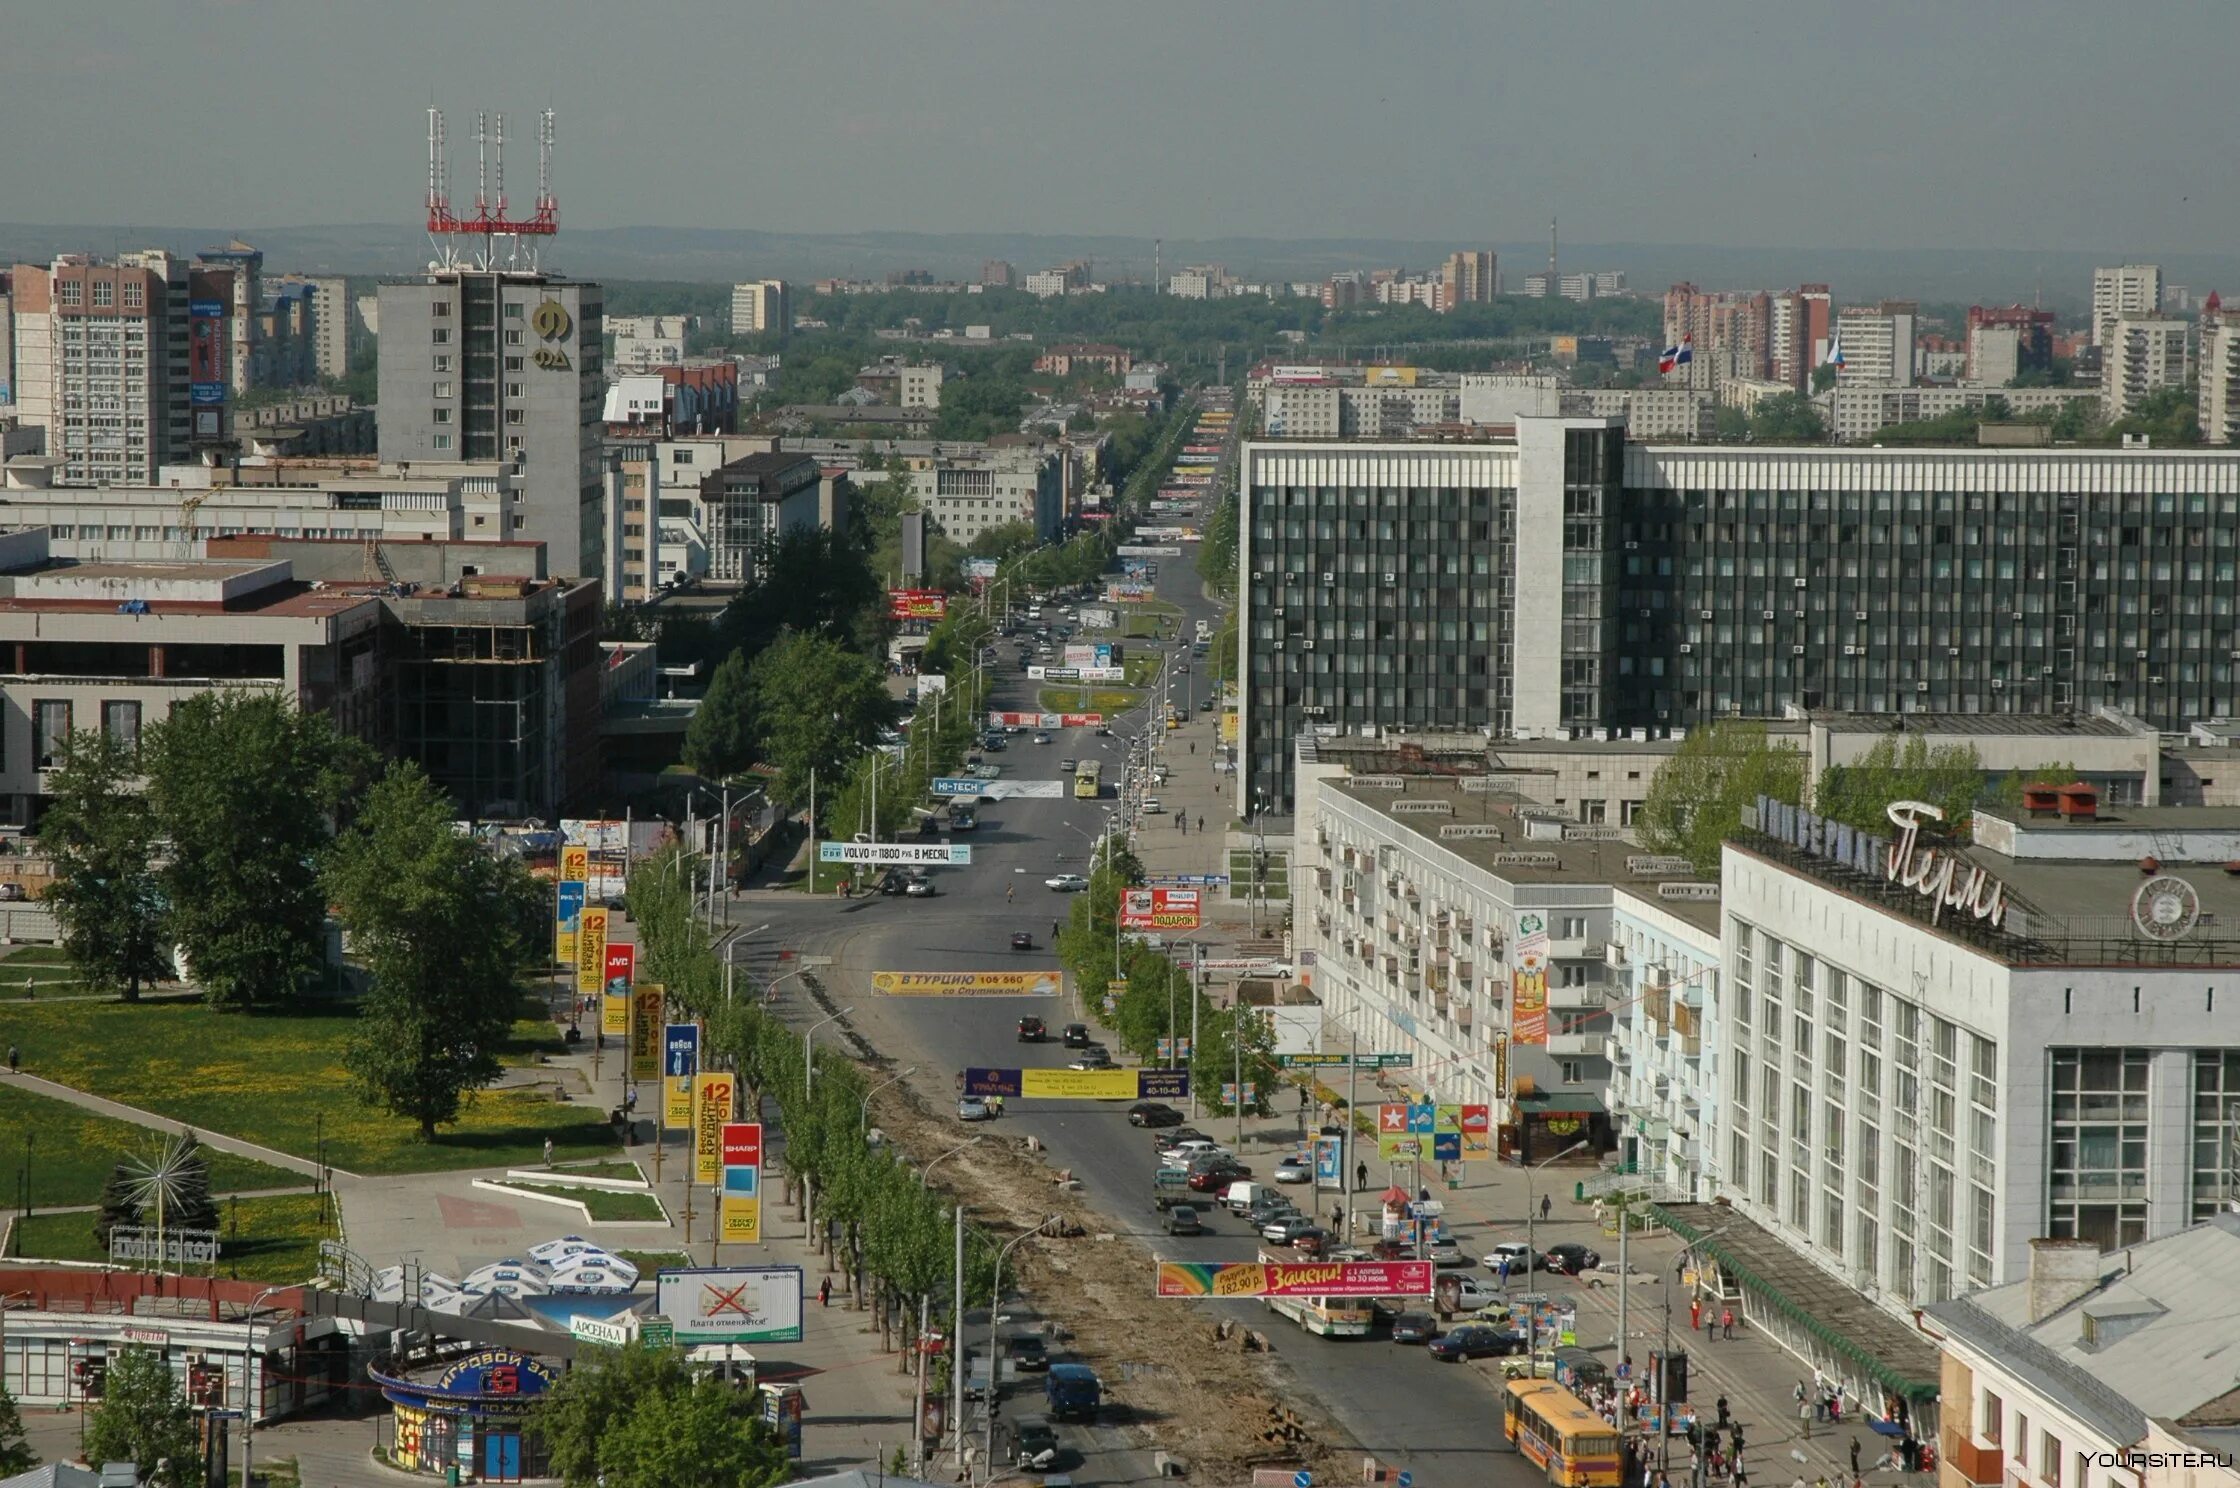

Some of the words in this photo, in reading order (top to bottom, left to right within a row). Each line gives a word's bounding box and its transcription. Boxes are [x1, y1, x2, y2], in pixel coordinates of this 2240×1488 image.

[938, 782, 978, 791] HI-TECH
[568, 854, 586, 867] 12
[844, 847, 869, 859] VOLVO
[878, 848, 900, 860] 11800
[914, 849, 920, 859] В
[922, 849, 949, 861] МЕСЯЦ
[1886, 800, 2006, 927] Пермь
[586, 916, 605, 930] 12
[1154, 915, 1196, 926] ПОДАРОК!
[1517, 949, 1543, 958] МАСЛО
[609, 957, 629, 966] JVC
[901, 975, 910, 985] В
[915, 974, 975, 986] ТУРЦИЮ
[957, 986, 1025, 996] Спутником!
[638, 993, 660, 1010] 12
[705, 1083, 730, 1102] 12
[1146, 1086, 1180, 1095] 40-10-40
[706, 1107, 716, 1155] КРЕДИТ
[1271, 1264, 1342, 1290] Зацени!
[1221, 1276, 1251, 1295] 182.90
[1253, 1276, 1262, 1289] р.
[690, 1319, 714, 1328] Плата
[575, 1320, 621, 1342] АРСЕНАЛ
[426, 1400, 469, 1412] ДОБРО
